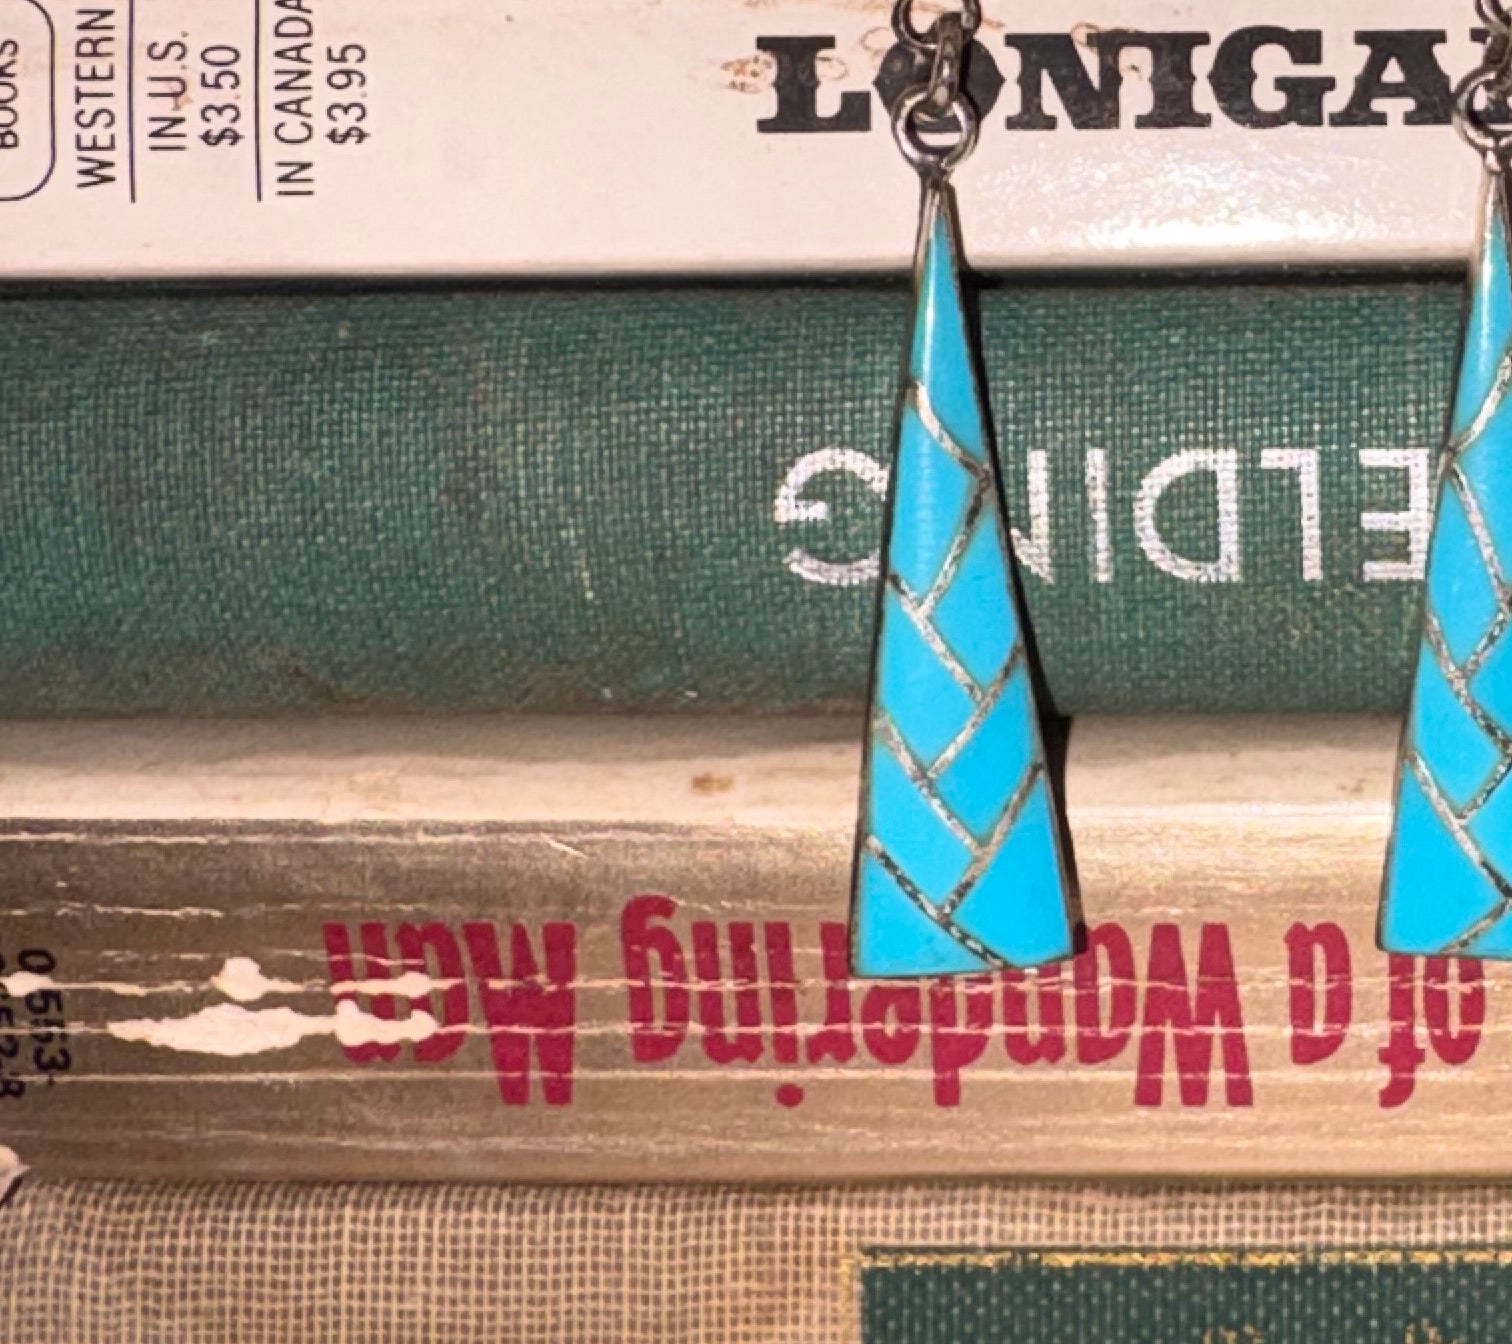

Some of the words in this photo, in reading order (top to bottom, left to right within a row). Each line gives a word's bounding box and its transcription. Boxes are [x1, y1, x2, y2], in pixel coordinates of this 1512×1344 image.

[75, 8, 117, 189] WESTERN
[146, 30, 190, 98] U.S.
[199, 44, 244, 147] $3.50
[325, 43, 371, 145] $3.95
[147, 116, 189, 152] IN
[275, 161, 315, 197] IN
[322, 921, 577, 1107] Man
[1283, 921, 1353, 1066] a
[1378, 955, 1486, 1108] of
